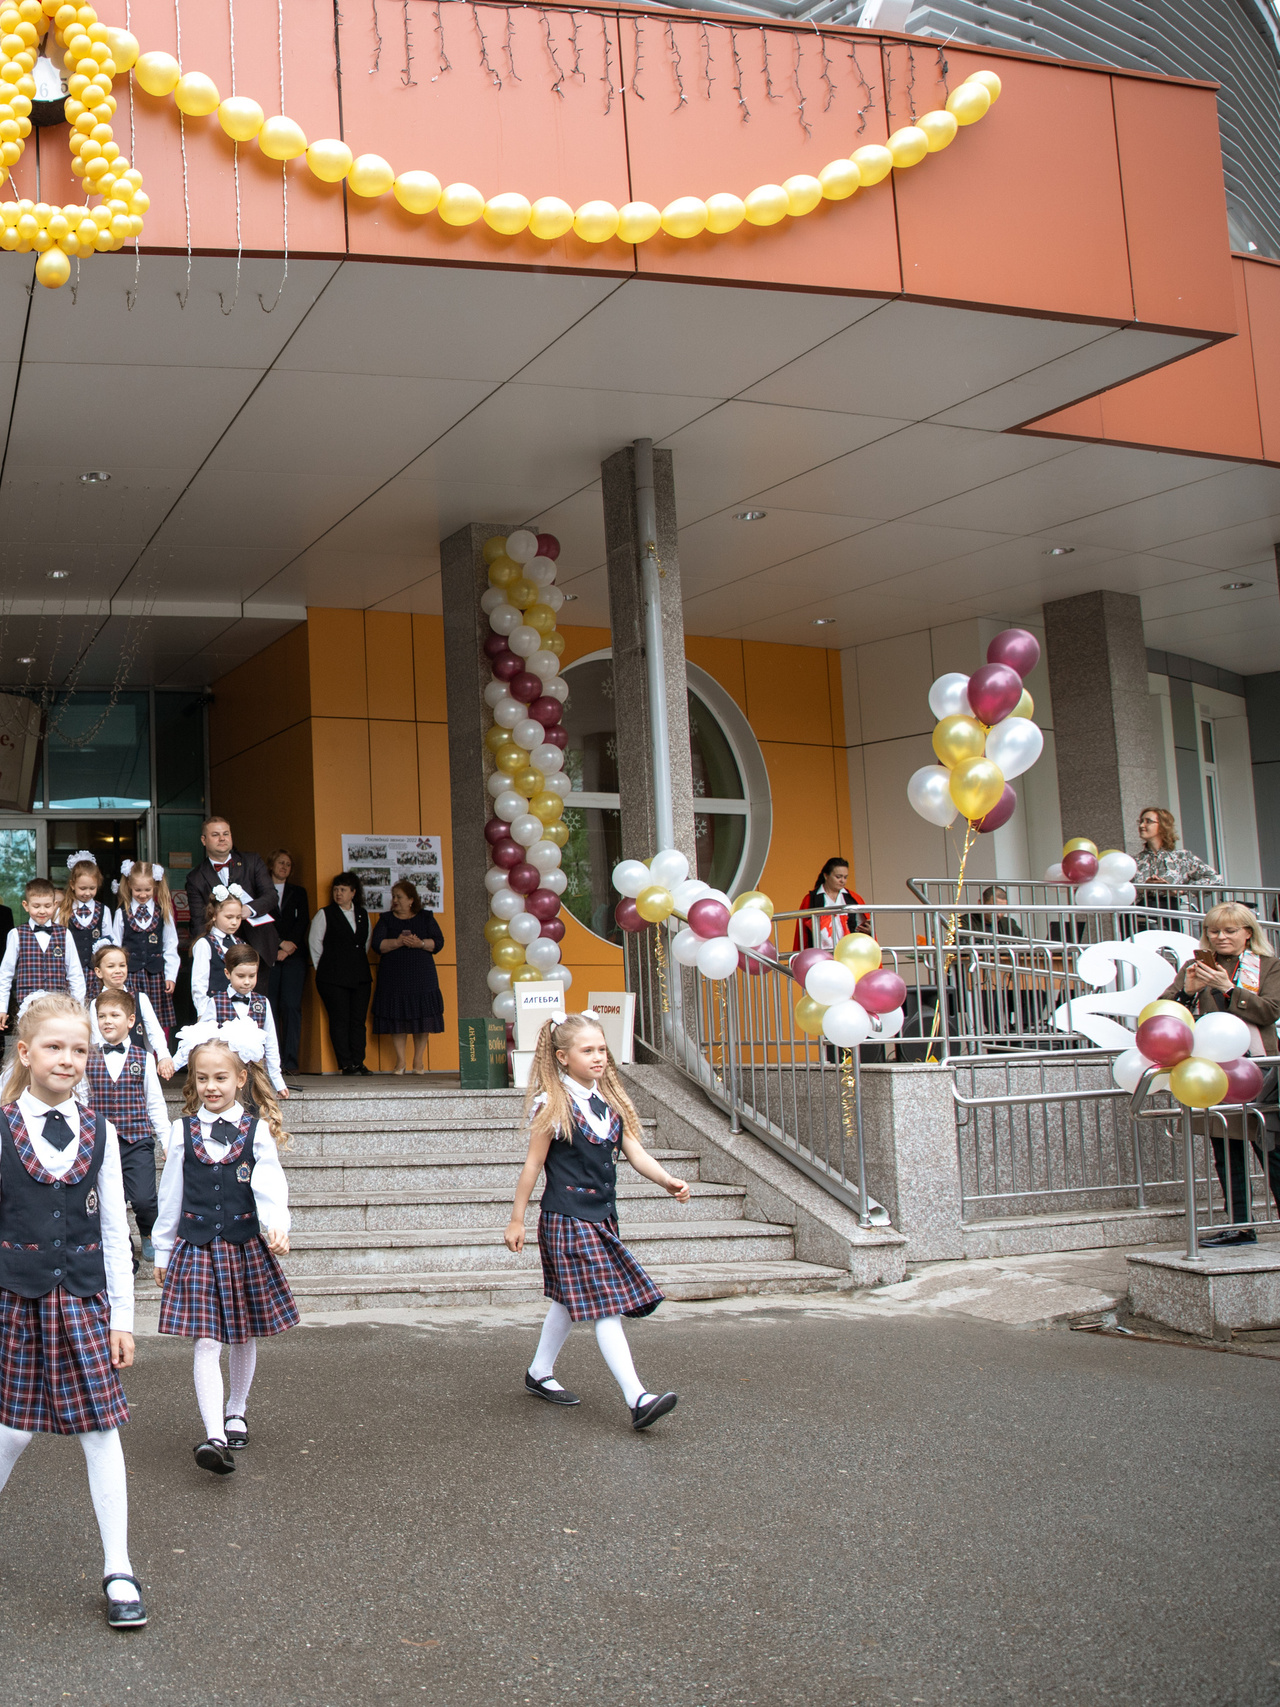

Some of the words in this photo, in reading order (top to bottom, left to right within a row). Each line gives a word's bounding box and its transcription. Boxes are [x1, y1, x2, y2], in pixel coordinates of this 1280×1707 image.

[39, 82, 49, 98] 6
[523, 996, 559, 1004] АЛГЕБРА
[592, 1005, 620, 1015] ИСТОРИЯ
[488, 1037, 506, 1051] ВОЙНА
